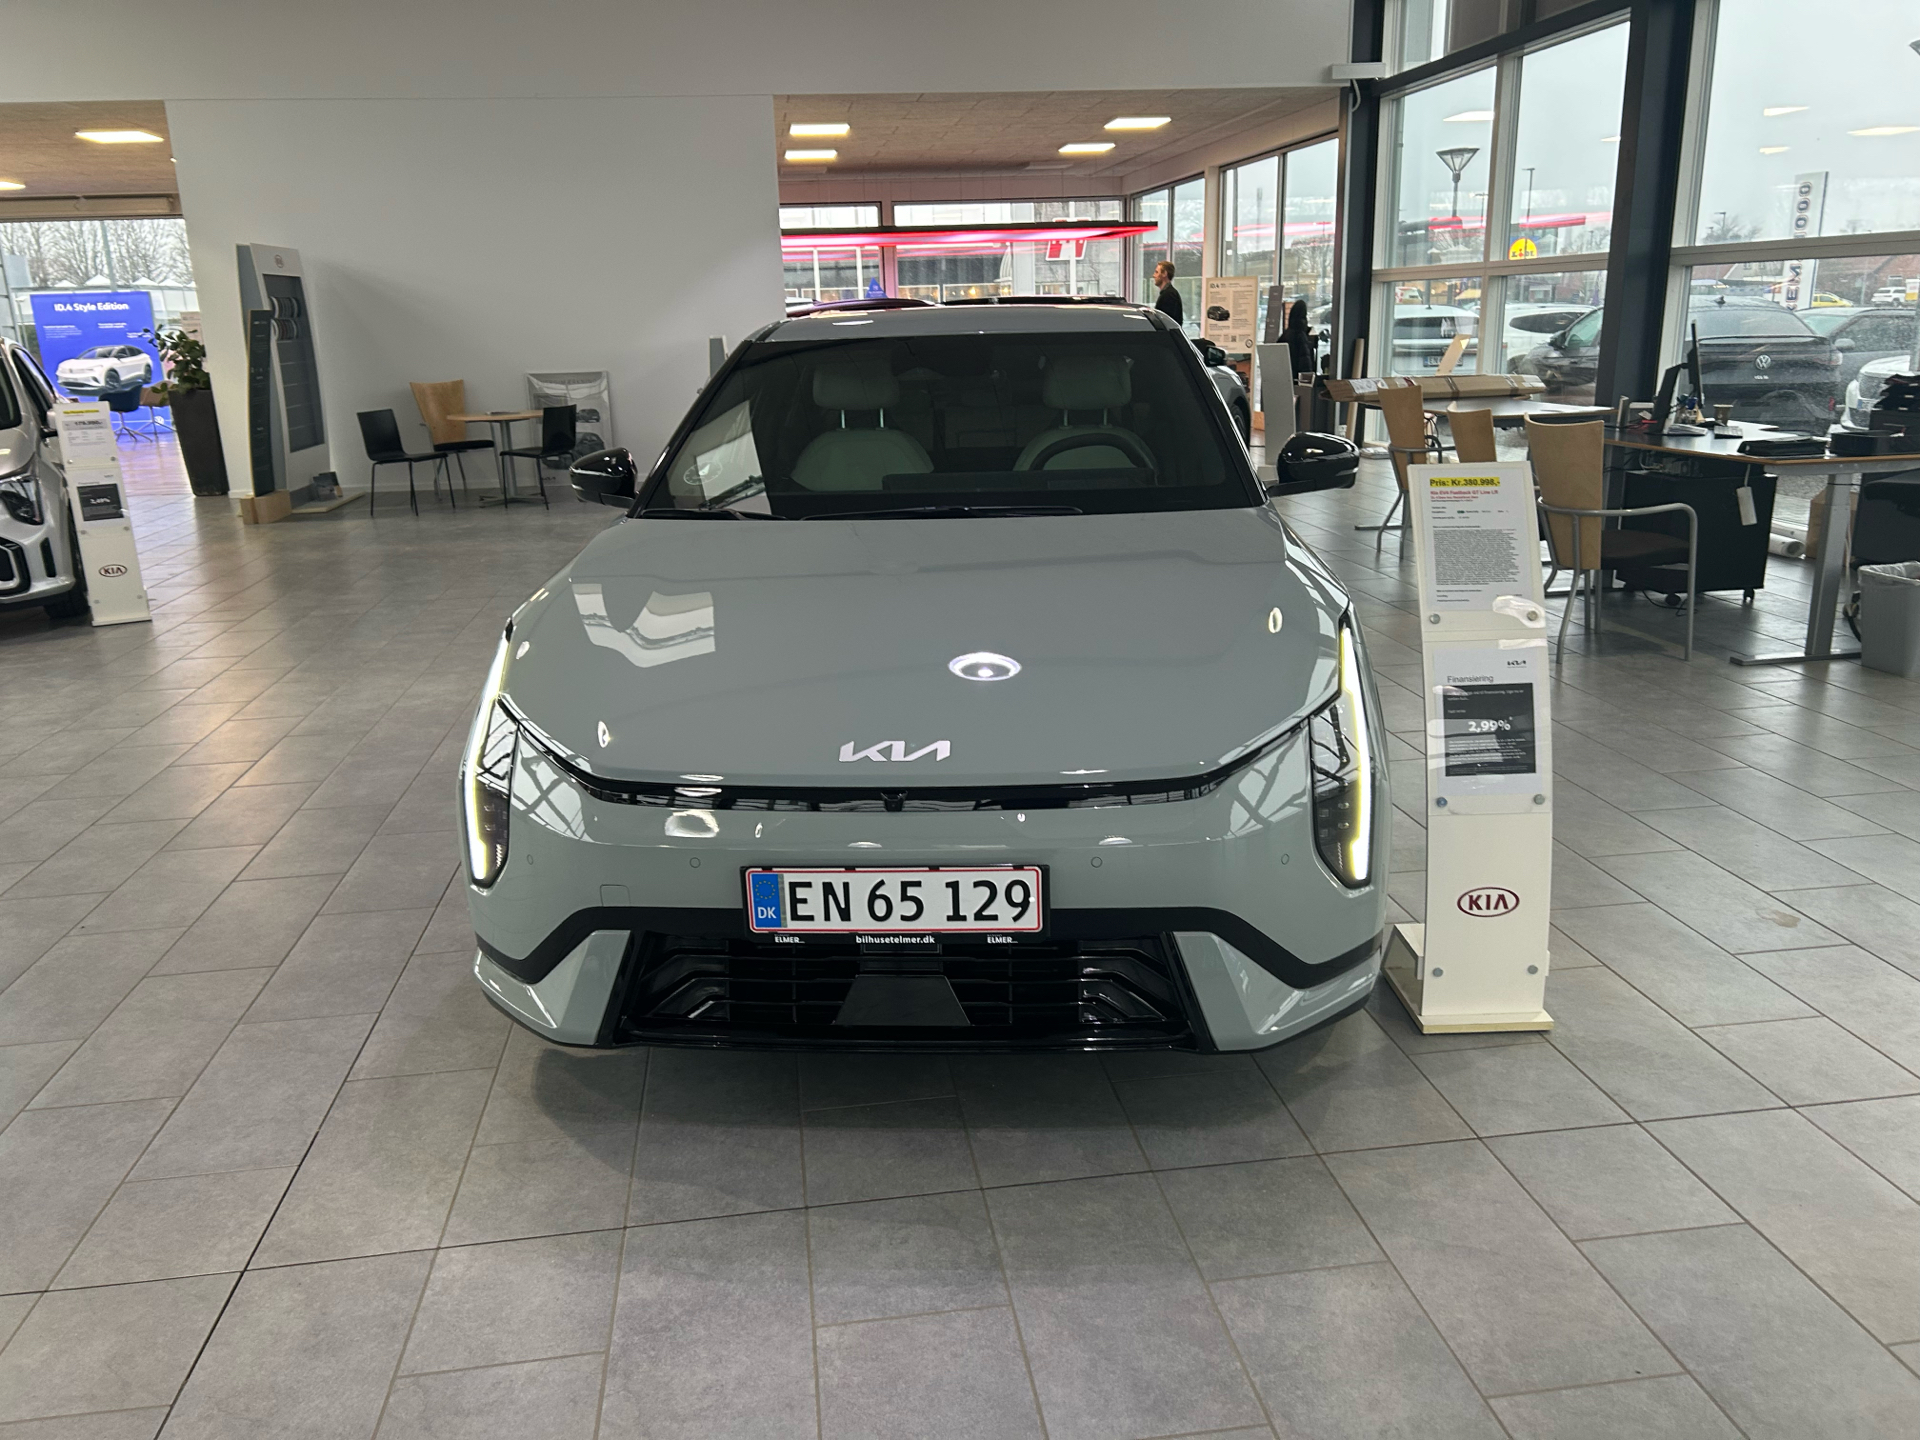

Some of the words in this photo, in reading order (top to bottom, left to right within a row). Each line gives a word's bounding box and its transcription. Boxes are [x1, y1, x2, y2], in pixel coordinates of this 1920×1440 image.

[53, 303, 73, 312] ID.4
[73, 302, 97, 313] Style
[97, 301, 129, 311] Edition
[1429, 478, 1450, 487] Pris:
[1451, 477, 1501, 487] Kr.380.998,-
[103, 567, 123, 575] KIA
[1447, 675, 1494, 684] Finansiering
[838, 740, 951, 762] KIA
[788, 881, 852, 922] EN
[866, 879, 925, 922] 65
[945, 879, 1031, 923] 129
[1467, 893, 1510, 912] KIA
[757, 906, 777, 919] DK
[855, 935, 935, 945] bilhusetelmer.dk
[986, 936, 1012, 944] ELMER
